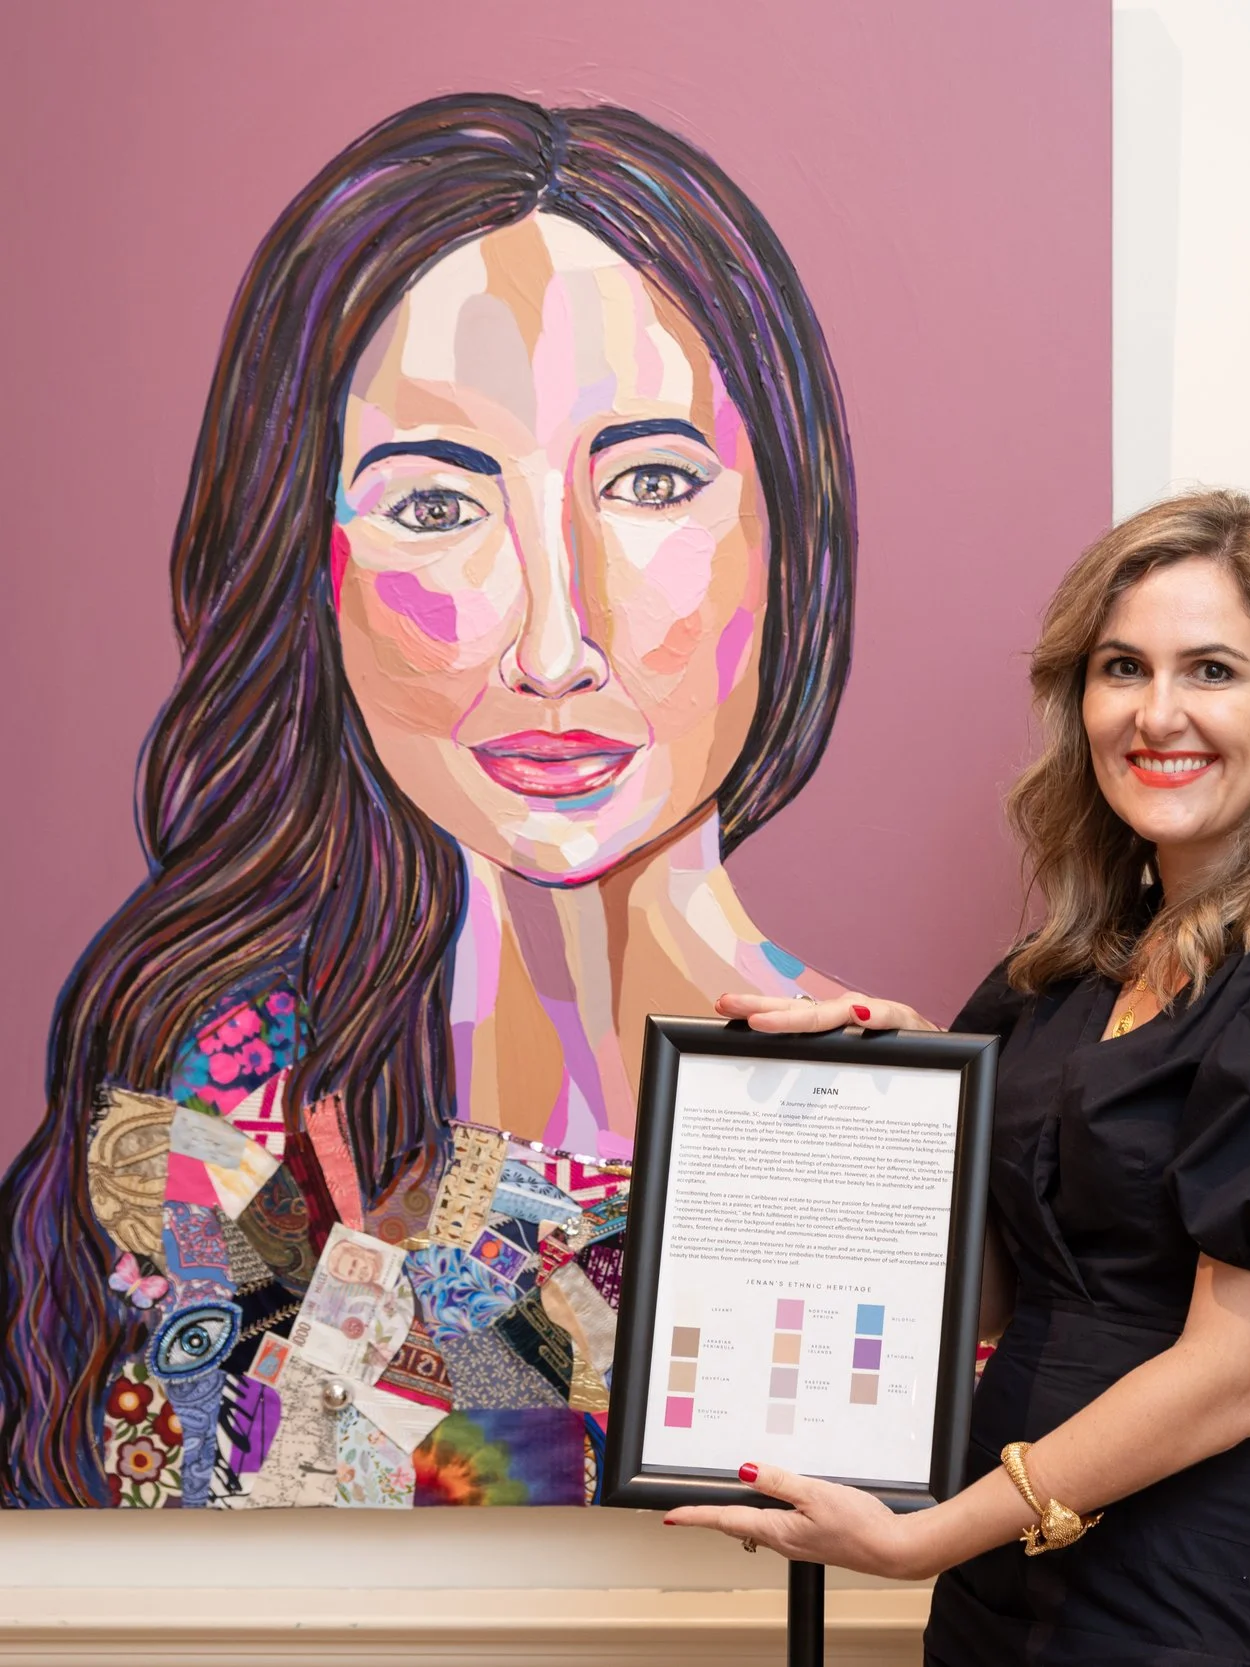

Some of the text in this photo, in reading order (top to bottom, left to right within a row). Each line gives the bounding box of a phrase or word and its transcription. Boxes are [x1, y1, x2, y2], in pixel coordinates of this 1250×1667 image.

[812, 1087, 839, 1096] JENAN
[682, 1115, 715, 1123] complexities
[675, 1189, 709, 1198] Transitioning
[738, 1227, 776, 1235] understanding
[746, 1279, 872, 1293] JENAN'S ETHNIC HERITAGE
